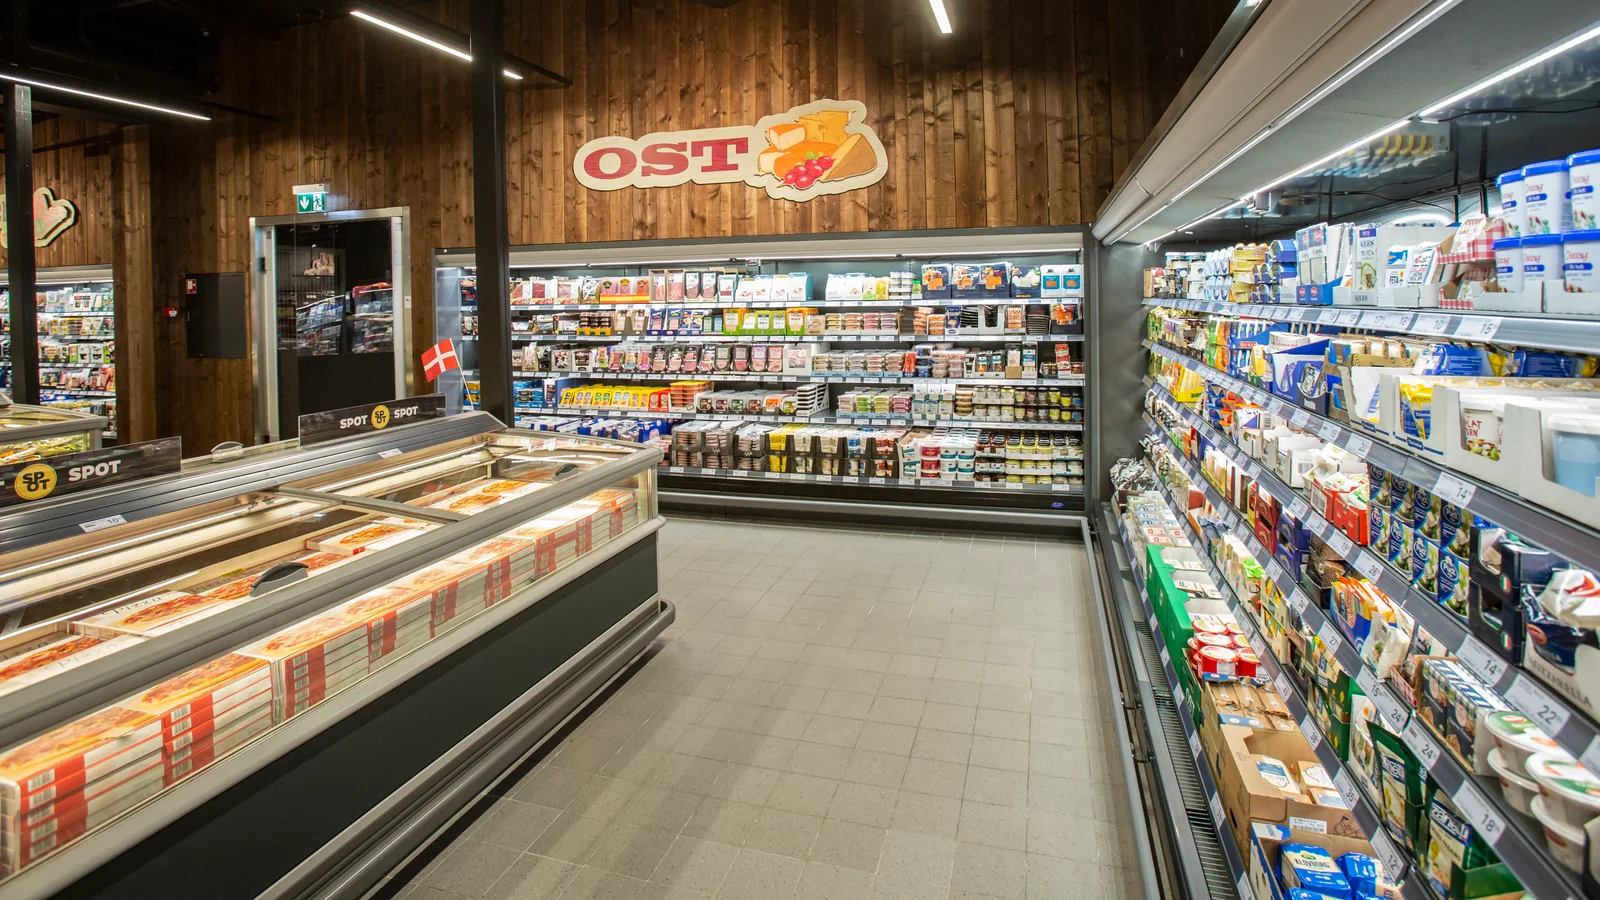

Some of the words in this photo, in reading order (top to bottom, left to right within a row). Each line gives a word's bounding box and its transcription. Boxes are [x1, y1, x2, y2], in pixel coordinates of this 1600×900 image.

[583, 136, 749, 180] OST
[1480, 322, 1493, 335] 15
[340, 415, 368, 429] SPOT
[394, 406, 418, 419] SPOT
[68, 460, 121, 481] SPOT
[1457, 488, 1467, 500] 14
[1483, 659, 1498, 675] 14
[1391, 708, 1402, 721] 24
[1538, 704, 1557, 725] 22
[1421, 744, 1434, 760] 24
[1480, 813, 1497, 832] 18
[1387, 854, 1398, 871] 12
